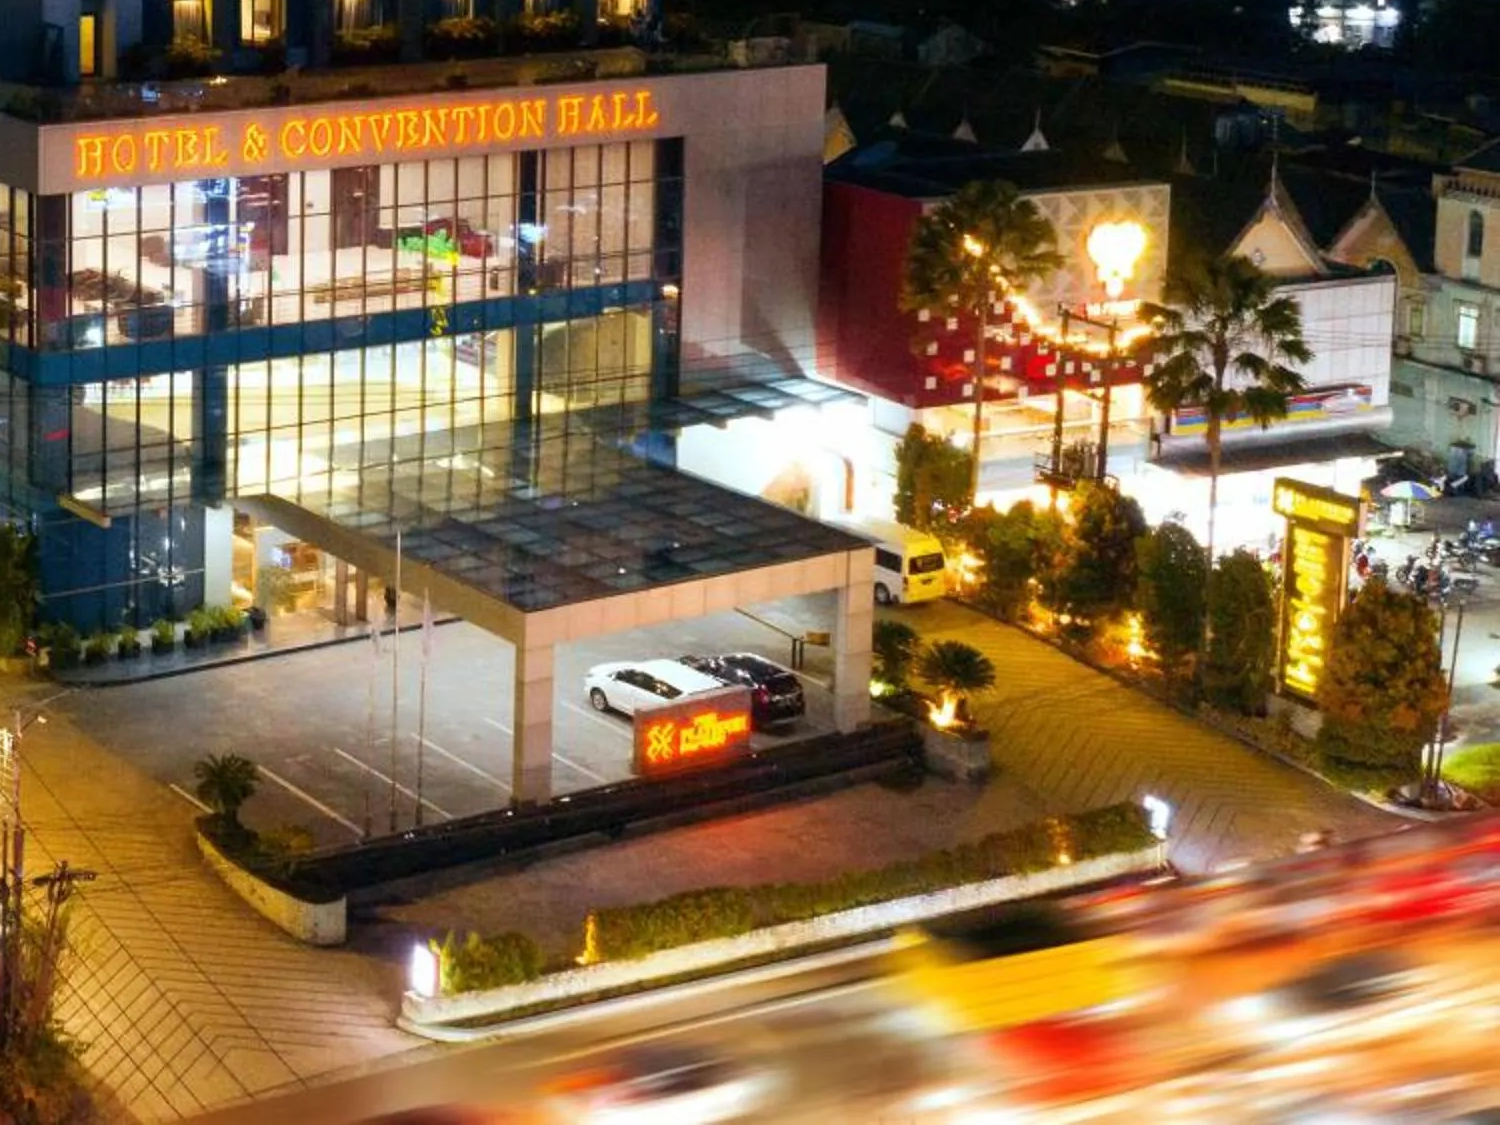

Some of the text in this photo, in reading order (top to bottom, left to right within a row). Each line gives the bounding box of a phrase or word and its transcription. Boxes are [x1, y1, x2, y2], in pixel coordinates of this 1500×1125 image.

[75, 90, 658, 177] HOTEL & CONVENTION HALL
